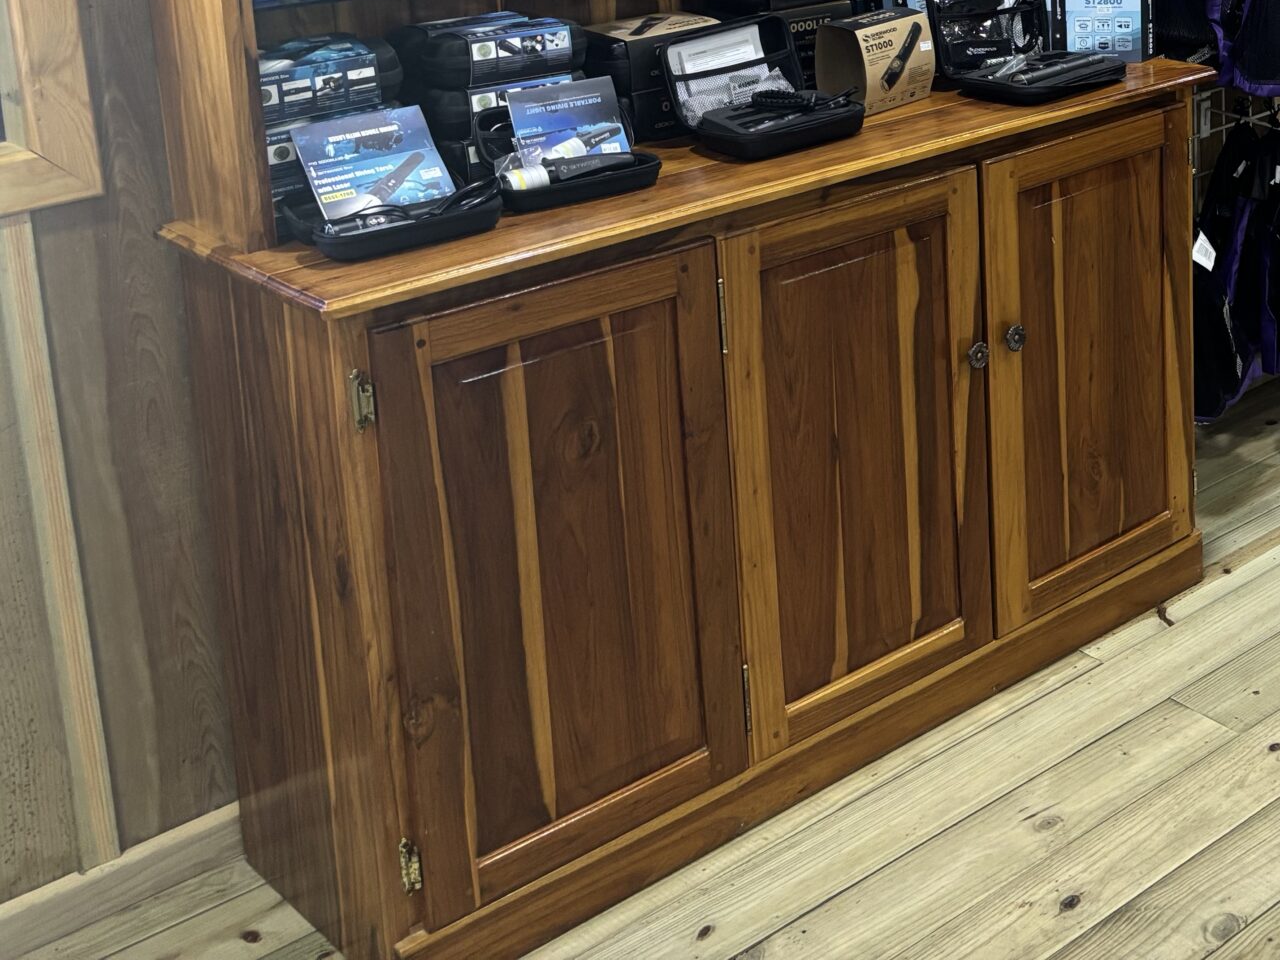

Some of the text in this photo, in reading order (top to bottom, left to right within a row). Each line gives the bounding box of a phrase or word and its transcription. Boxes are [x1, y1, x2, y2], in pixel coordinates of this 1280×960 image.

[869, 26, 898, 38] SHERWOOD
[864, 39, 894, 54] ST1000
[526, 96, 602, 116] PORTABLE DIVING LIGHT
